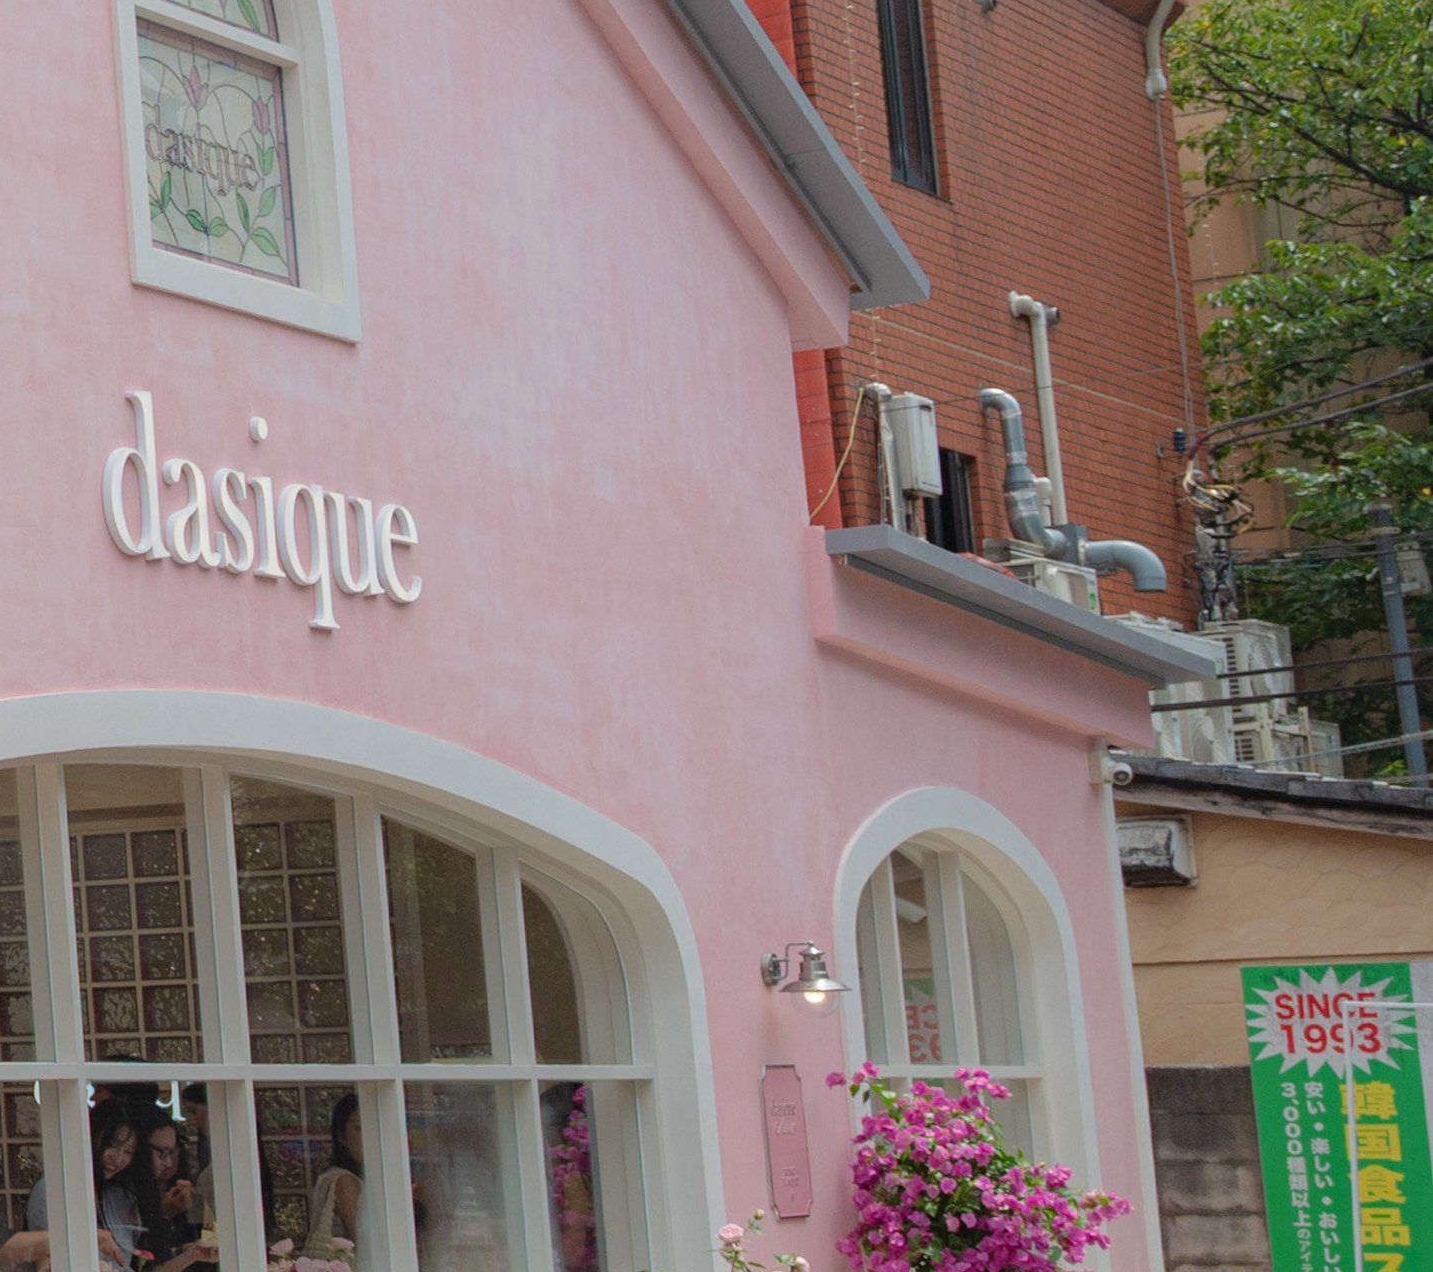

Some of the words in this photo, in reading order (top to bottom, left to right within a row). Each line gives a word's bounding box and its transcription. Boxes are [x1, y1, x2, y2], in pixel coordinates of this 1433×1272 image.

[102, 390, 422, 629] dasique
[1274, 992, 1378, 1020] SINCE
[1280, 1022, 1382, 1054] 1993
